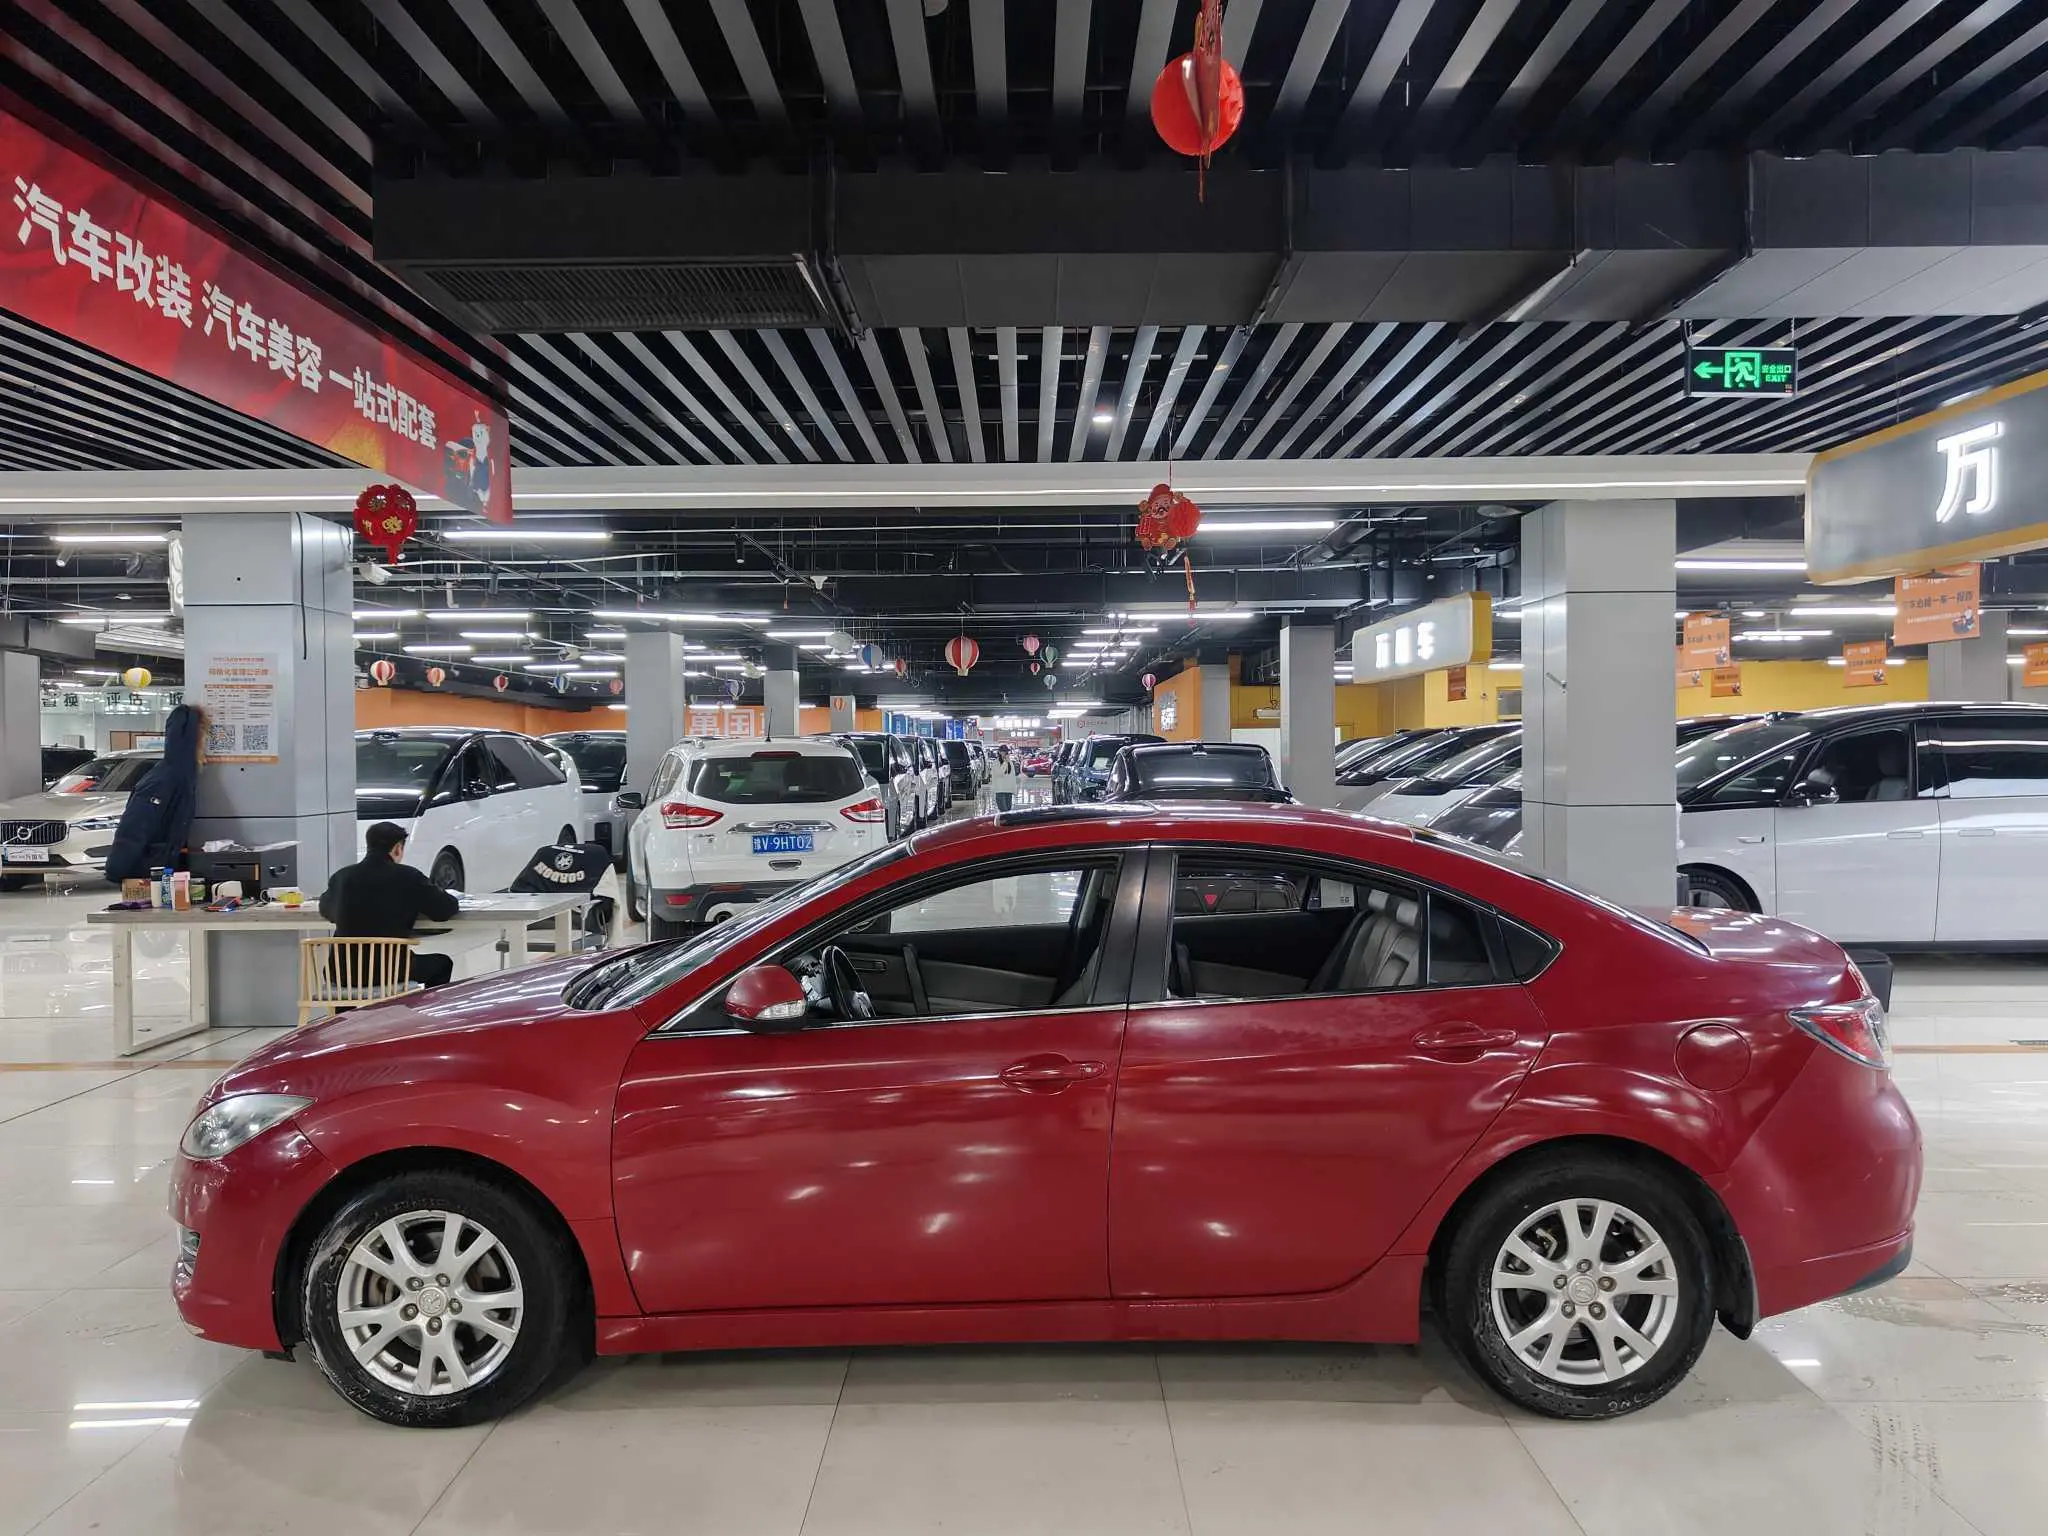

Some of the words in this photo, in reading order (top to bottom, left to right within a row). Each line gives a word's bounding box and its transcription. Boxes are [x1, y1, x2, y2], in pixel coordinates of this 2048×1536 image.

[13, 175, 193, 328] 汽车改装
[201, 280, 324, 393] 汽车美容
[328, 365, 437, 450] 一站式配套
[1761, 363, 1793, 374] 安全出口
[1765, 374, 1788, 382] EXIT
[1935, 421, 2005, 524] 万
[106, 692, 144, 707] 评估
